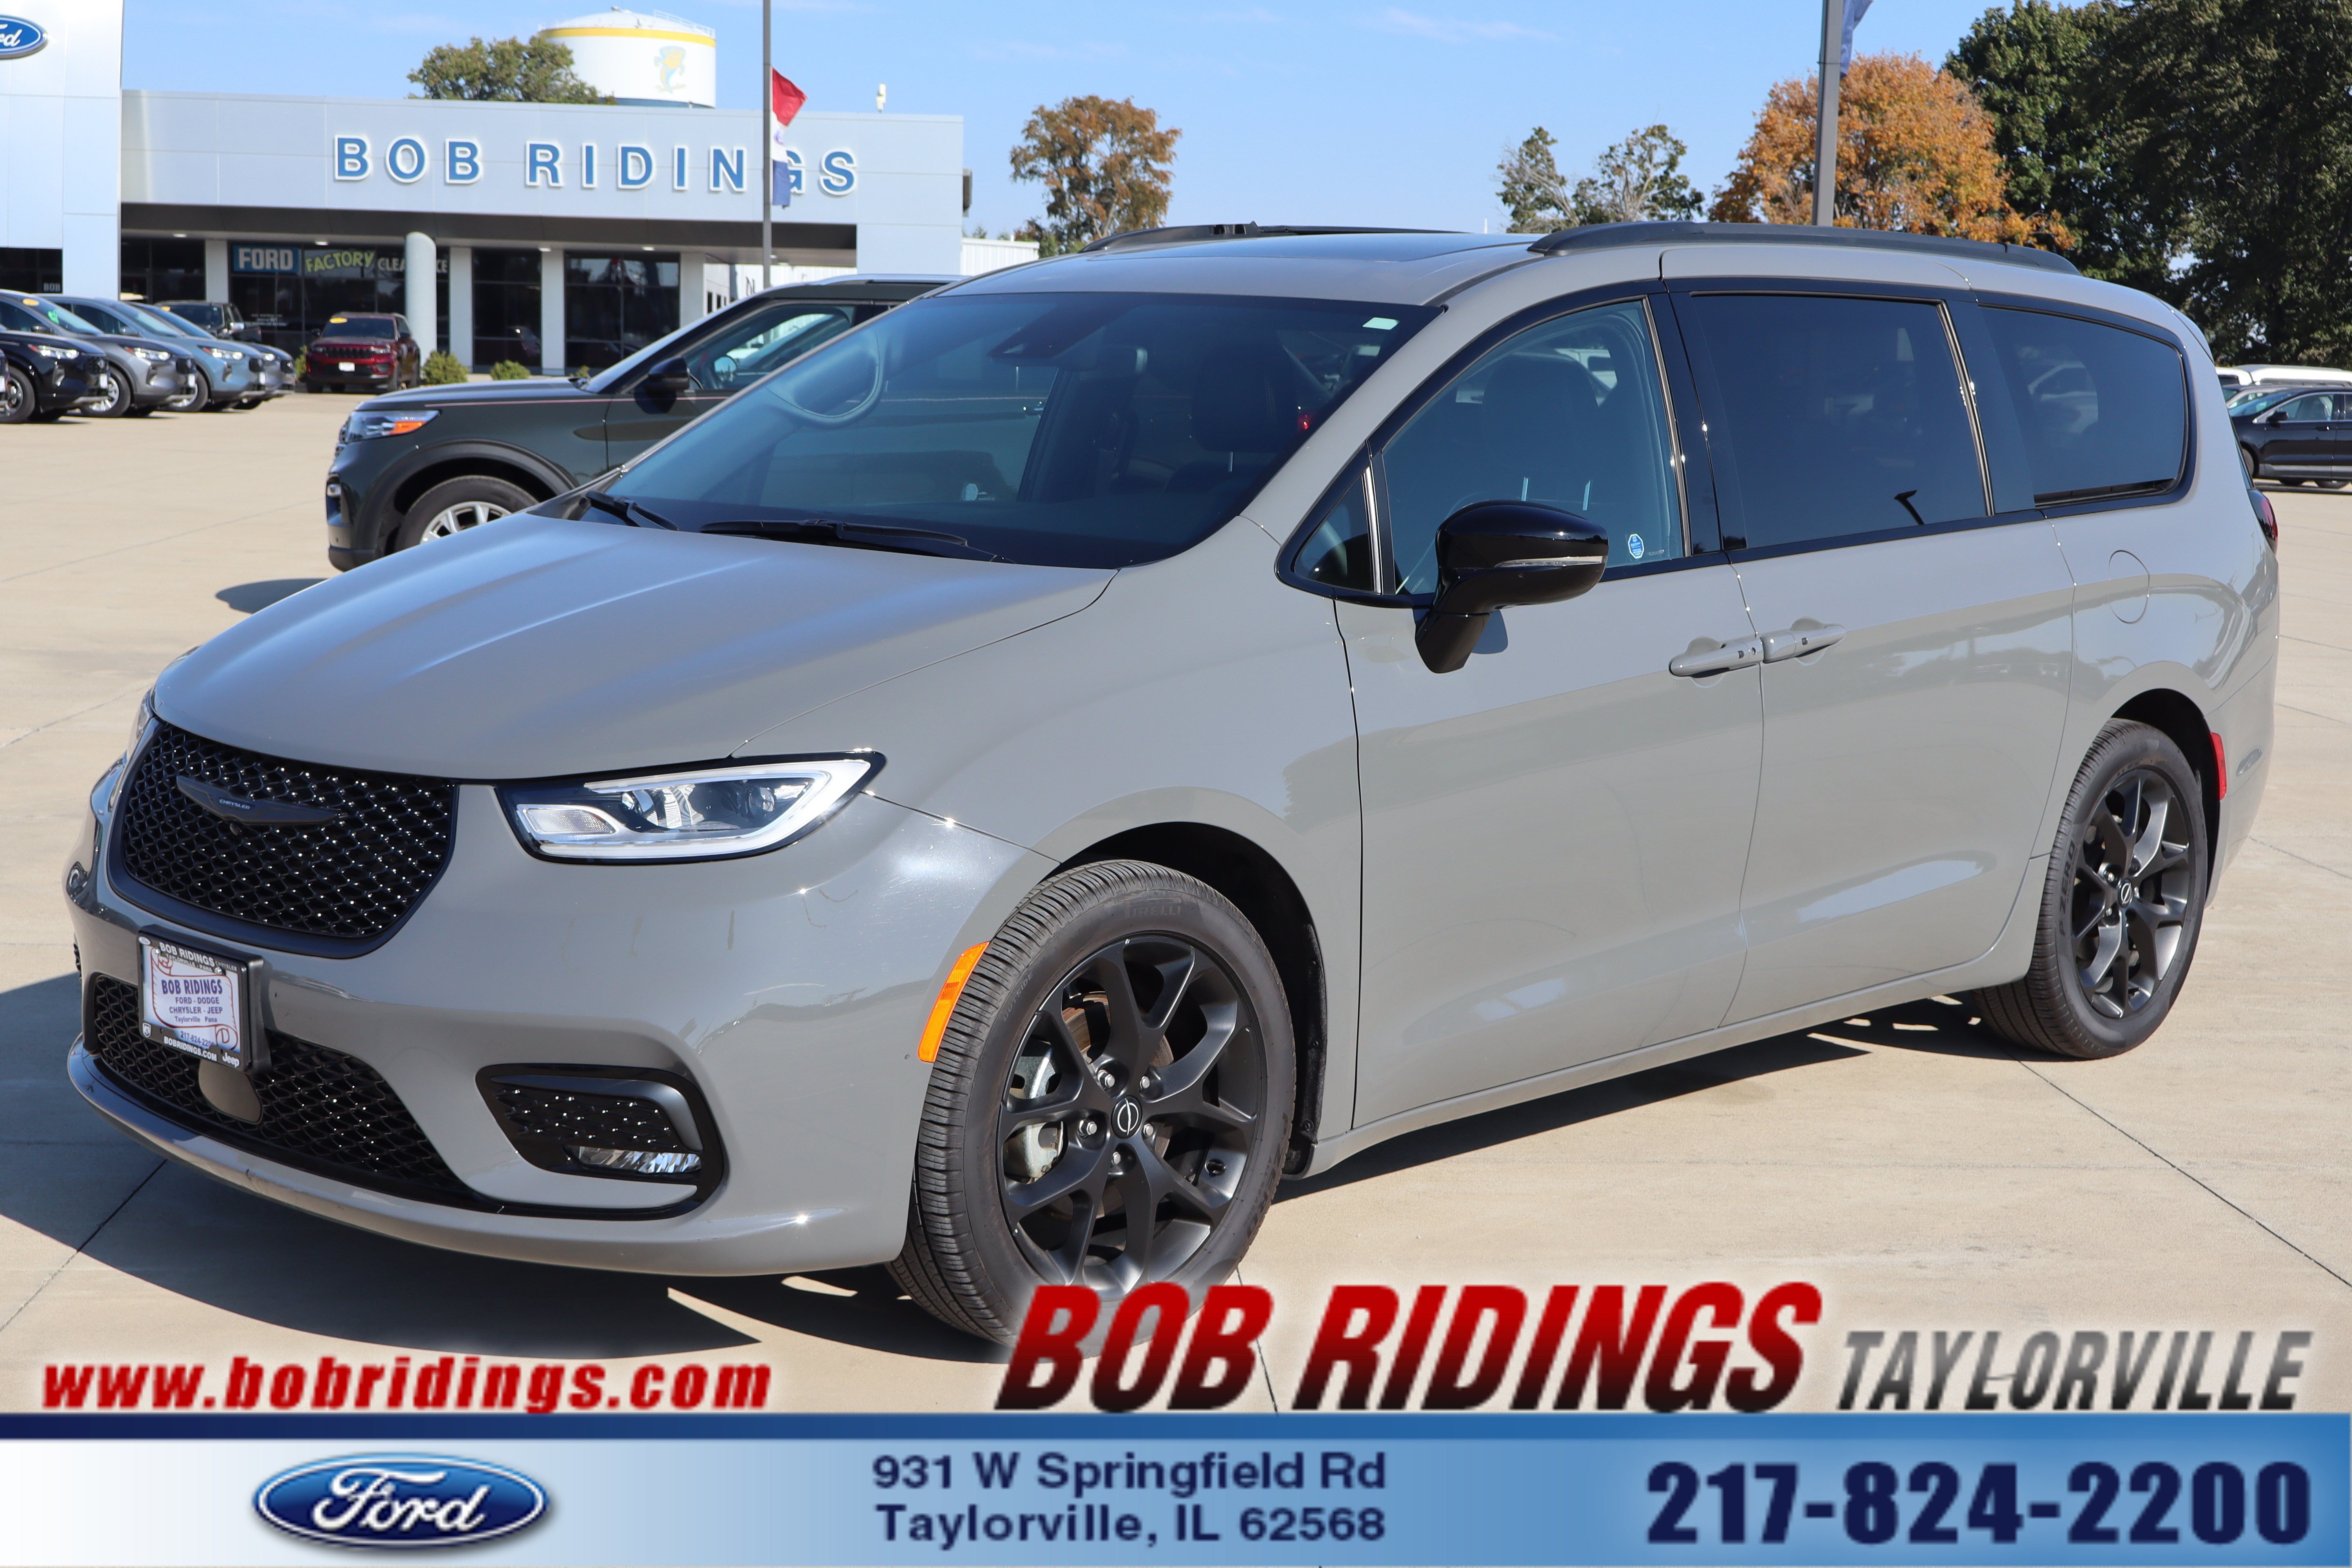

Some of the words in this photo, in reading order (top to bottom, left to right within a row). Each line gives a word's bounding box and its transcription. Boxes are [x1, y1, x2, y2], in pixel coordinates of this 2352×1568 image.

[336, 135, 481, 183] BOB
[238, 248, 294, 271] FORD
[305, 250, 375, 273] FACTORY
[377, 257, 448, 273] CLEACE
[219, 798, 251, 810] CHRYSLER
[159, 942, 178, 956] BOB
[179, 948, 216, 967] RIDINGS
[166, 954, 196, 967] TAYLORVILLE
[199, 964, 213, 973] PANA
[215, 961, 238, 972] CHRYSLER
[161, 979, 181, 994] BOB
[183, 978, 223, 994] RIDINGS
[164, 1036, 217, 1062] BOBRIDINGS.COM
[222, 1052, 240, 1068] Jeep
